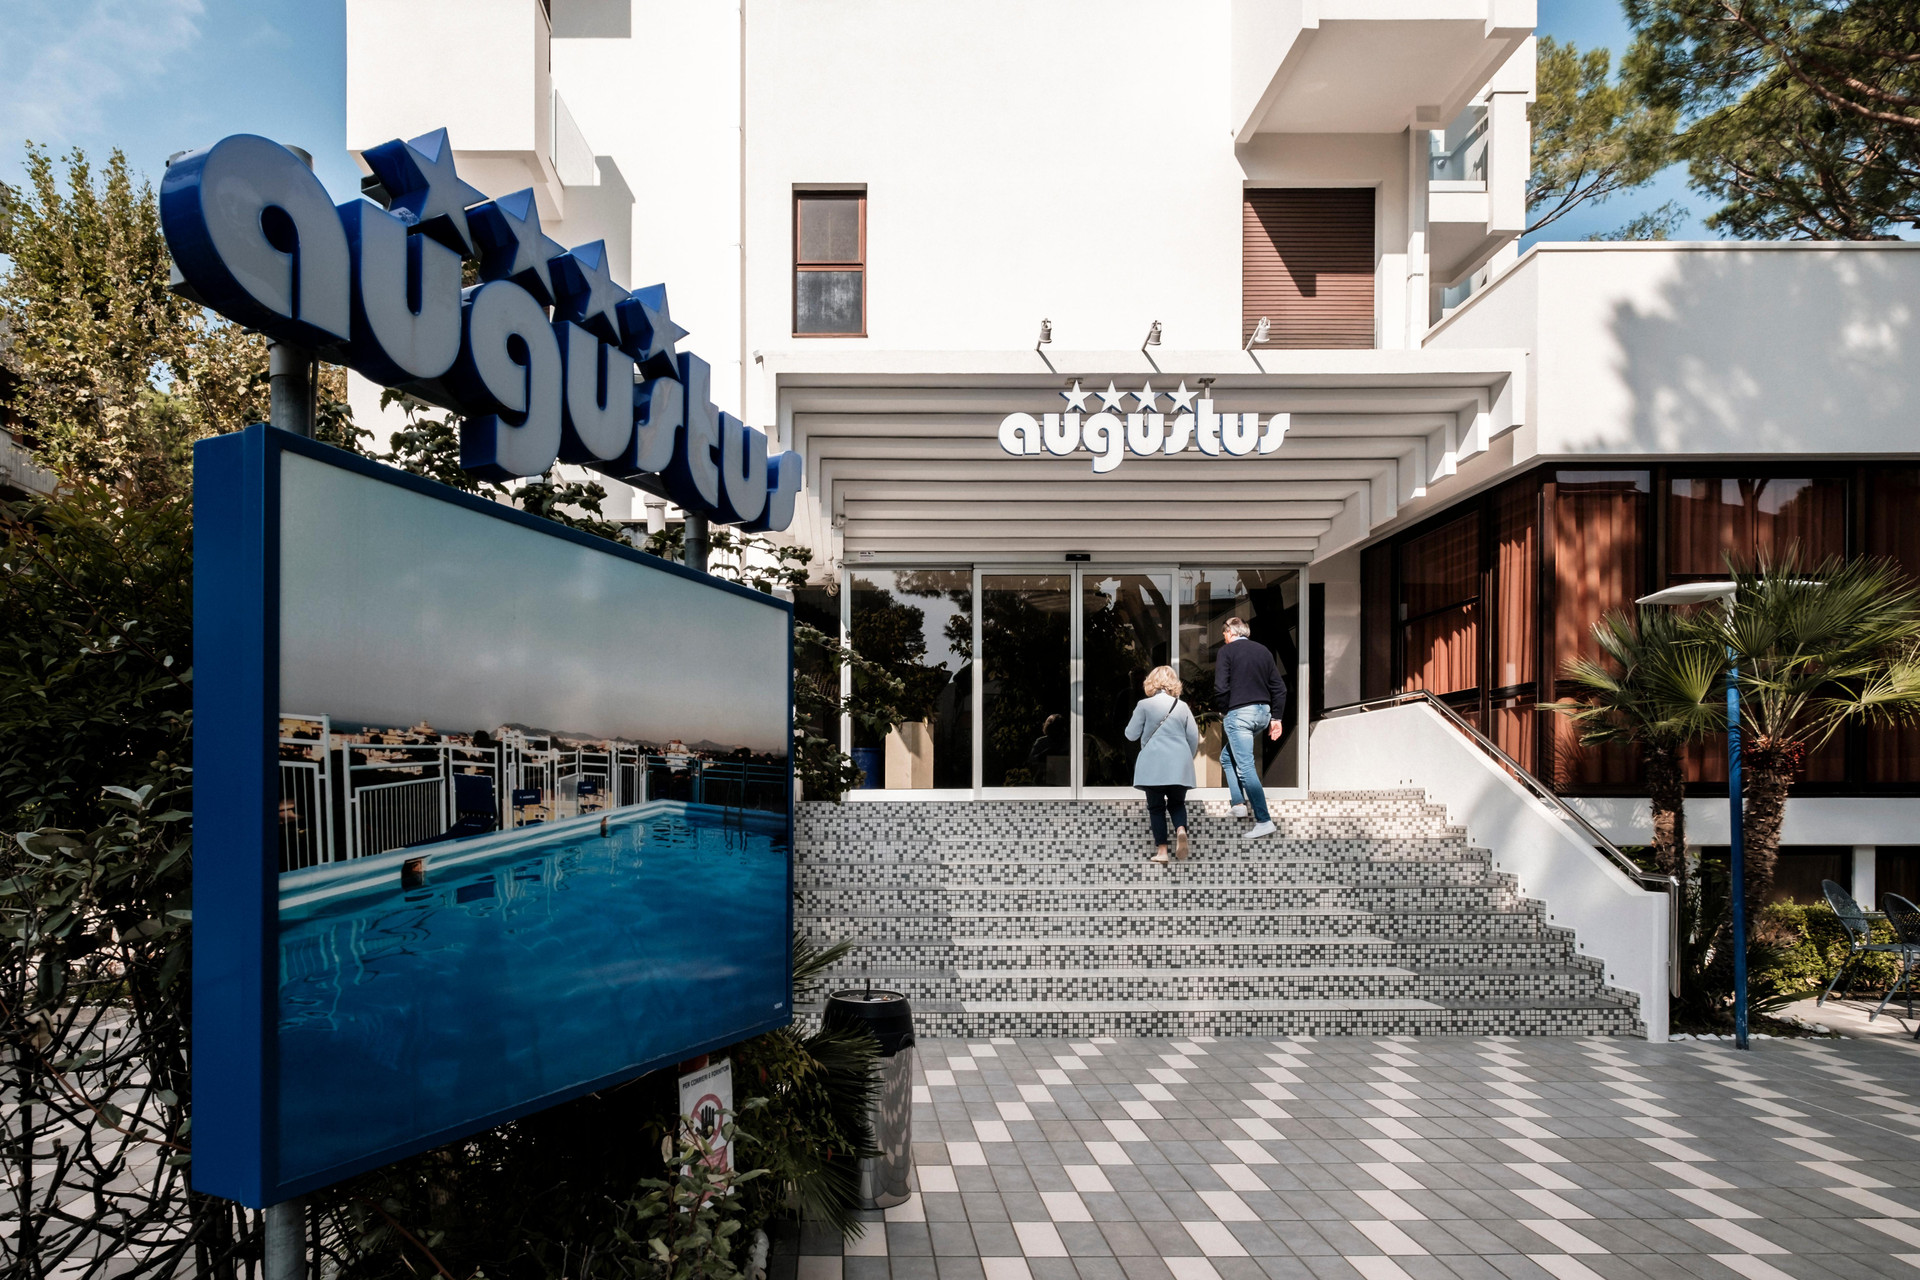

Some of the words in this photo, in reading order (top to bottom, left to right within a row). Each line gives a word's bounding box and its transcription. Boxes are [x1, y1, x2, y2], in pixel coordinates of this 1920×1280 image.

[160, 134, 802, 532] augustus
[997, 398, 1291, 474] augustus
[682, 1081, 690, 1090] PER
